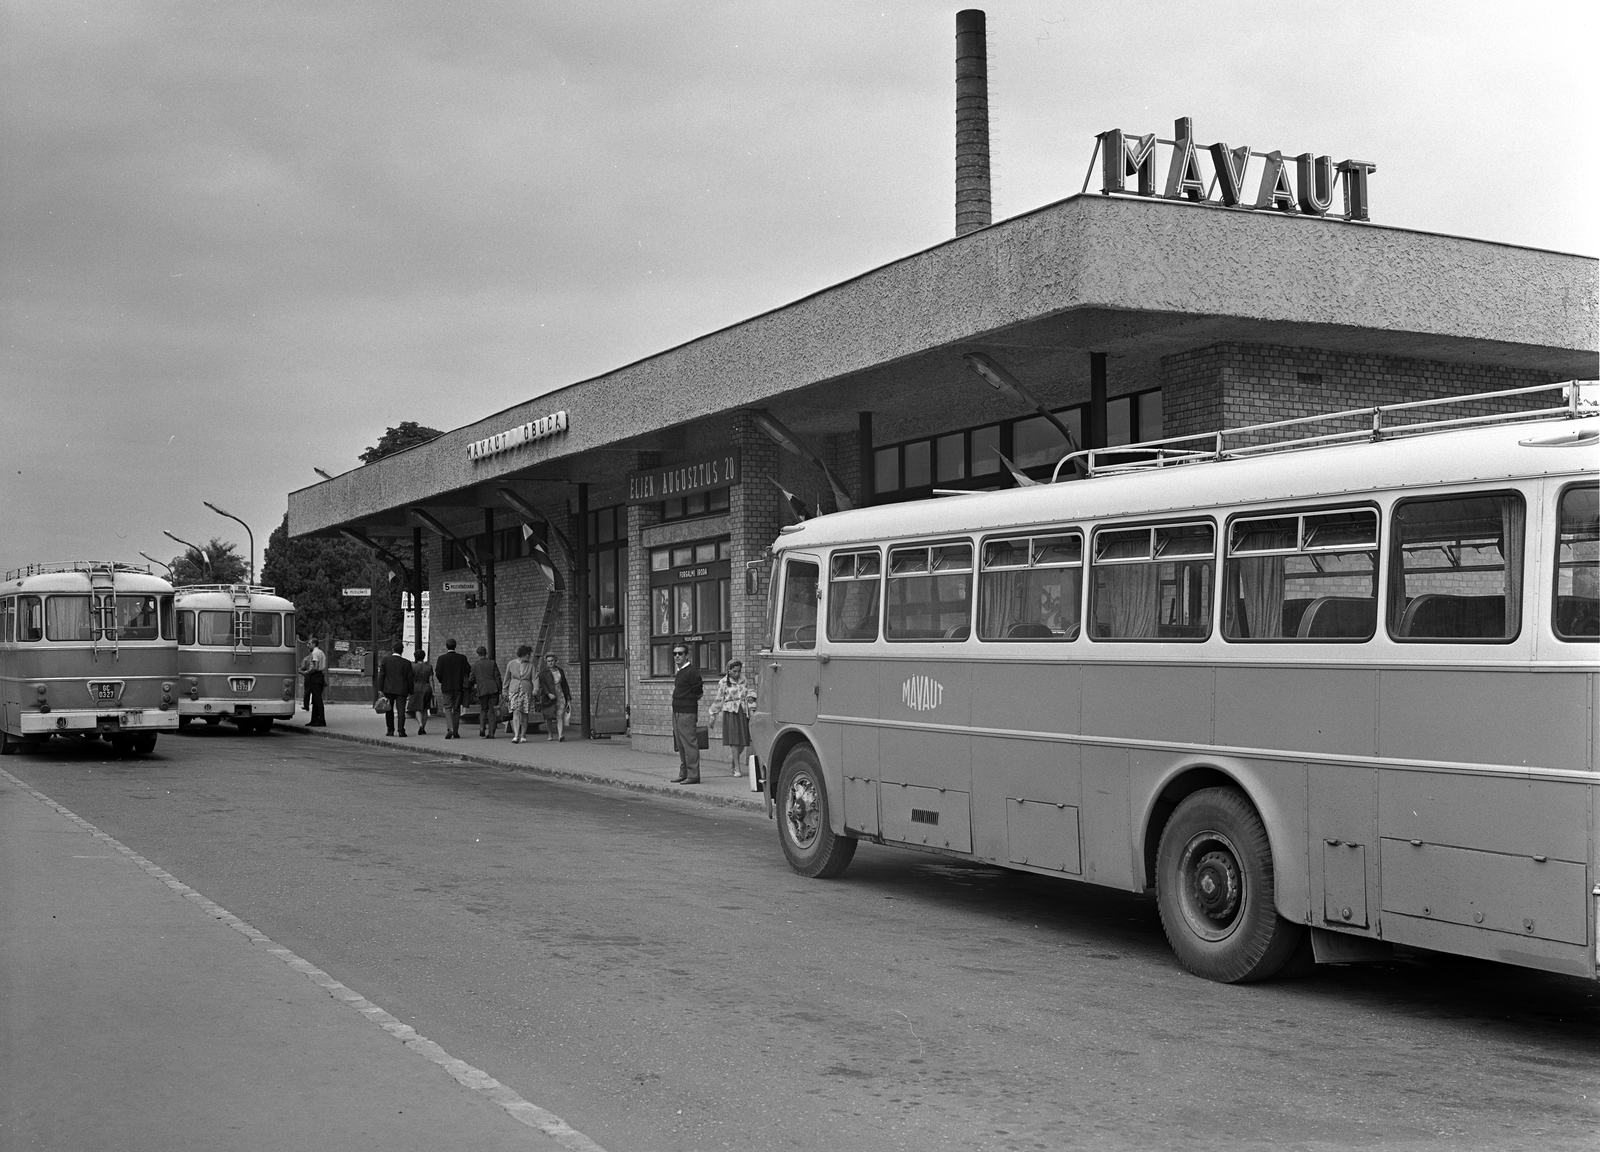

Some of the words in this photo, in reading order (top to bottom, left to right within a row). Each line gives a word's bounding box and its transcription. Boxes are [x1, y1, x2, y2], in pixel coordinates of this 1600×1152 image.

[662, 460, 718, 494] AUGUSZTUS
[725, 456, 735, 480] 20
[444, 582, 450, 591] 5
[98, 690, 114, 698] 0327
[902, 673, 944, 711] MÁVAUT
